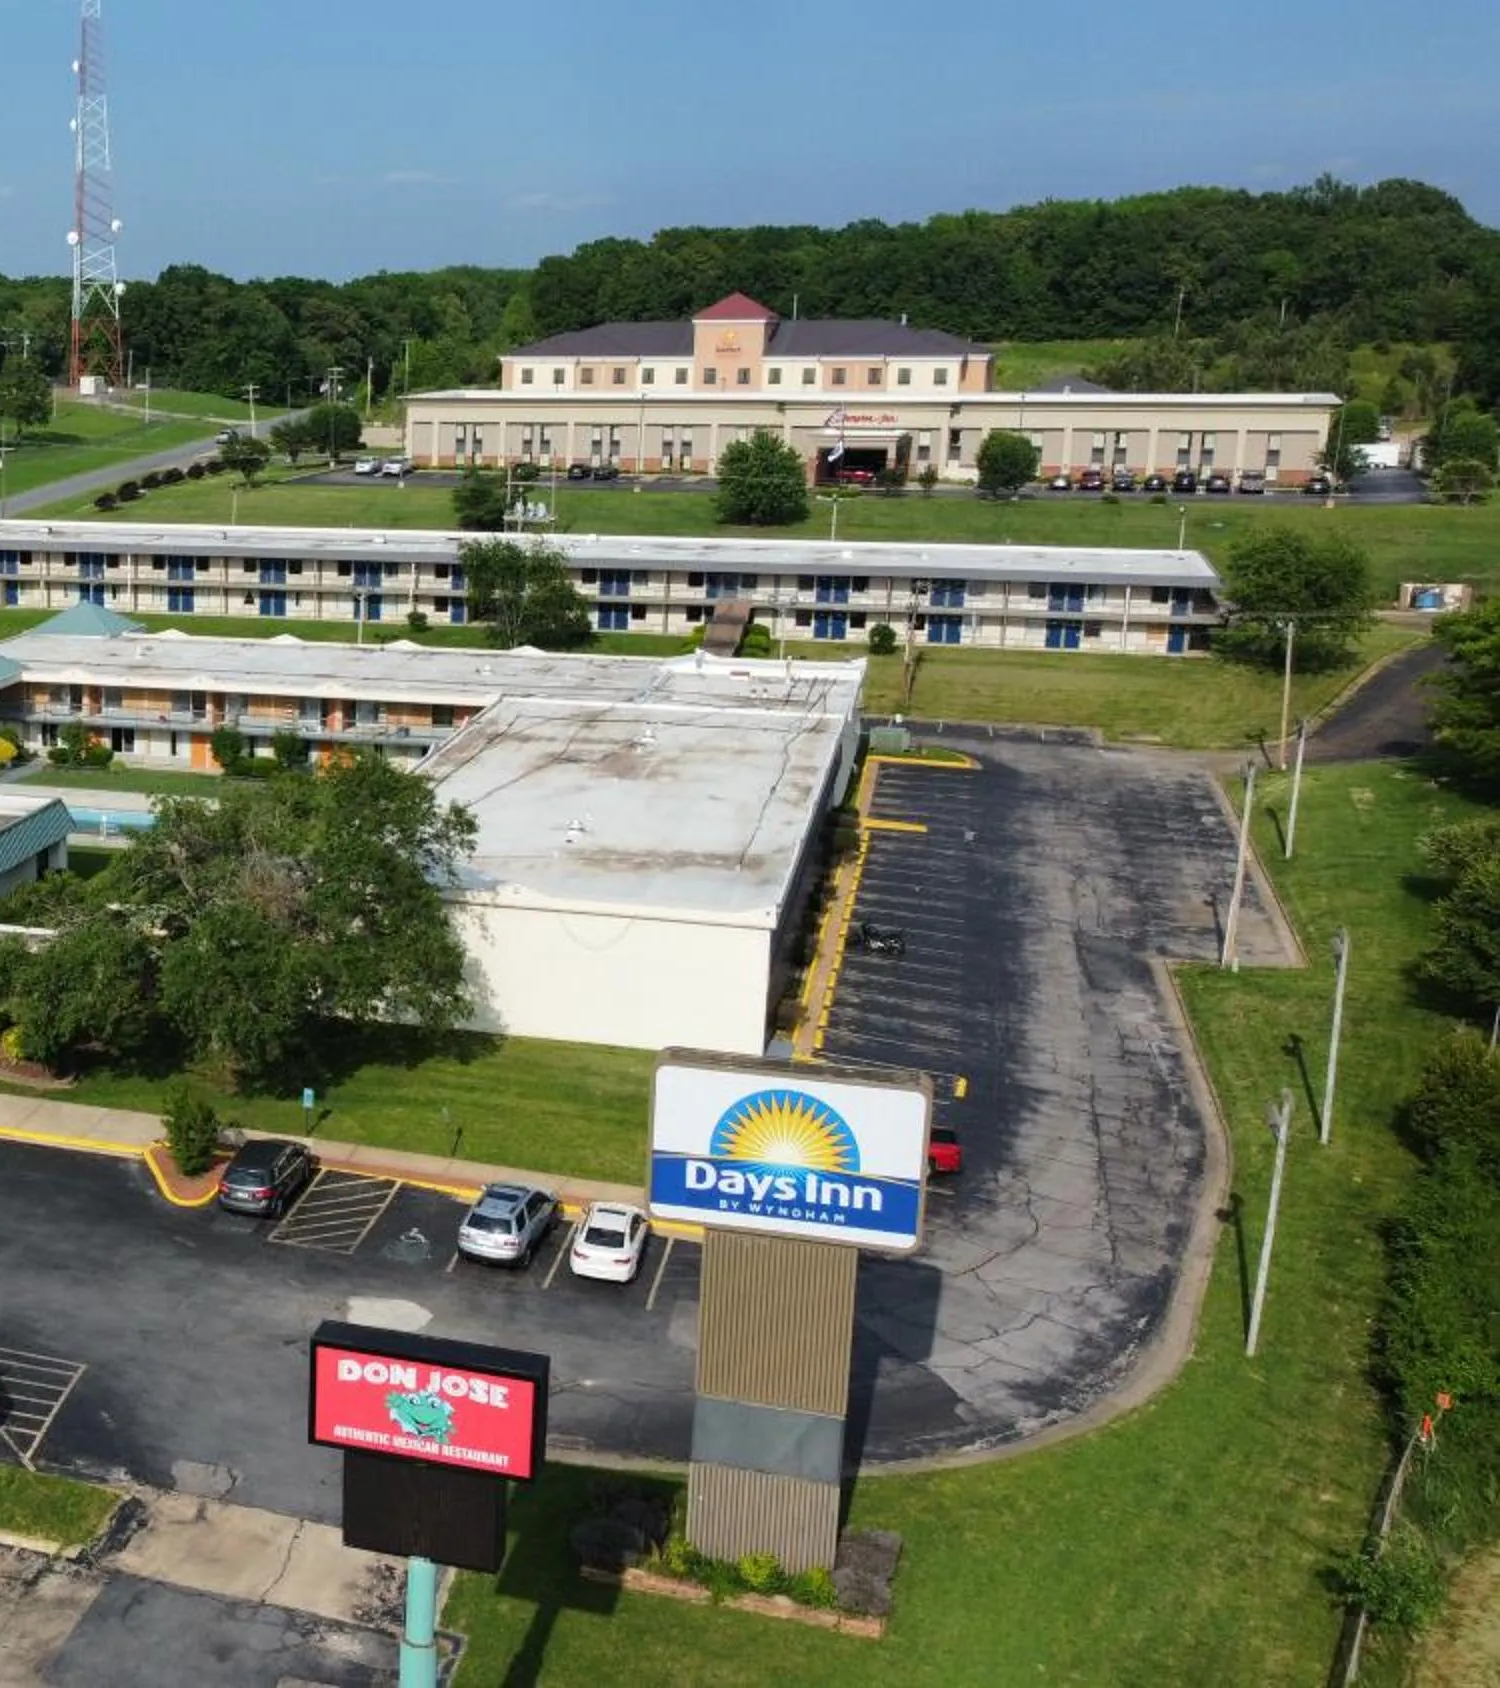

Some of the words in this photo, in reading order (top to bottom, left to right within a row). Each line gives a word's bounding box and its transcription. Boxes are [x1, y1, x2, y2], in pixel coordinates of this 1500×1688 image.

[685, 1159, 797, 1201] Days
[805, 1173, 883, 1212] Inn
[719, 1199, 740, 1210] BY
[749, 1203, 845, 1224] WYNDHAM
[337, 1359, 417, 1389] DON
[426, 1371, 509, 1409] JOSE
[333, 1424, 391, 1445] AUTHENTIC
[392, 1435, 440, 1456] MEXICAN
[441, 1443, 509, 1467] RESTAURANT
